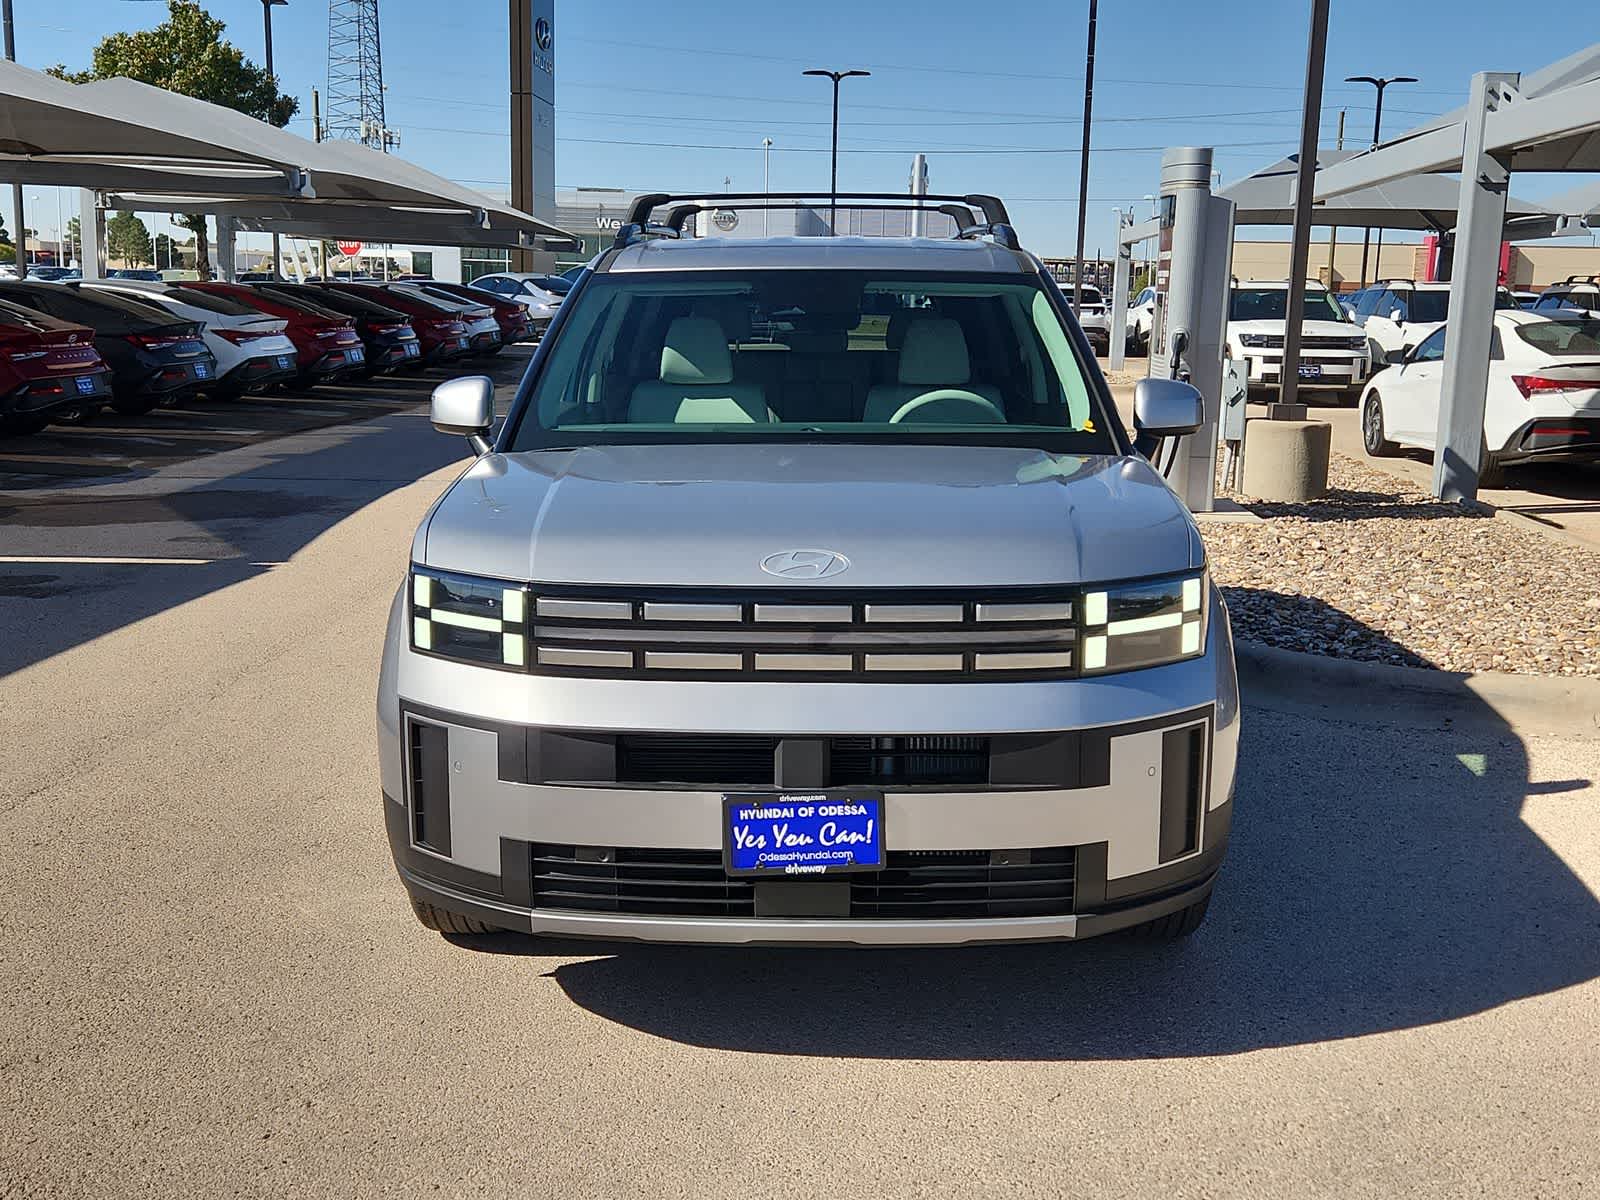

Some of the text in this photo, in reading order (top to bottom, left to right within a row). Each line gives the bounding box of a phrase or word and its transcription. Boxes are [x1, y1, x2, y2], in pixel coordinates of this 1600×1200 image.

[339, 240, 361, 248] STOP
[779, 794, 827, 803] driveway.com
[739, 805, 867, 820] HYUNDAI OF ODESSA
[733, 819, 874, 849] Yes You Can!
[758, 850, 853, 862] OdessaHyundai.com
[785, 863, 827, 874] driveway
